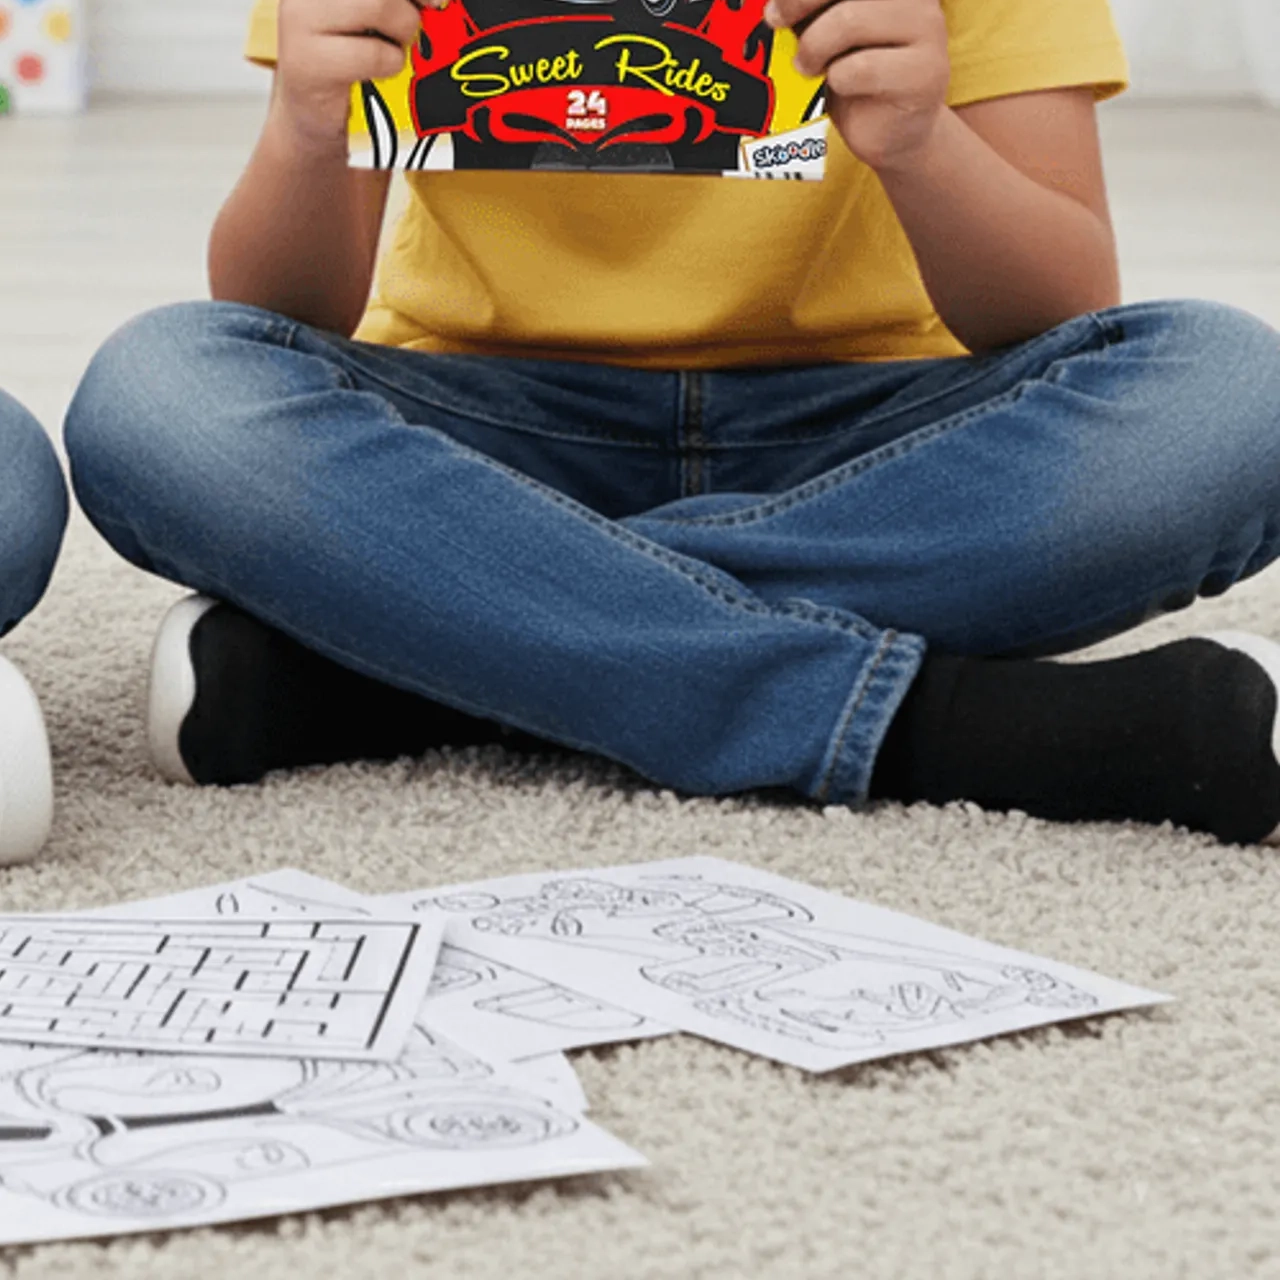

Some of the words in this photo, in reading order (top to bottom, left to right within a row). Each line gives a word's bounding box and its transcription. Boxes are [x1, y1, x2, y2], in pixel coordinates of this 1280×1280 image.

[450, 45, 582, 97] Sweet
[594, 33, 731, 102] Rides
[566, 89, 608, 116] 24
[566, 117, 606, 131] PAGES
